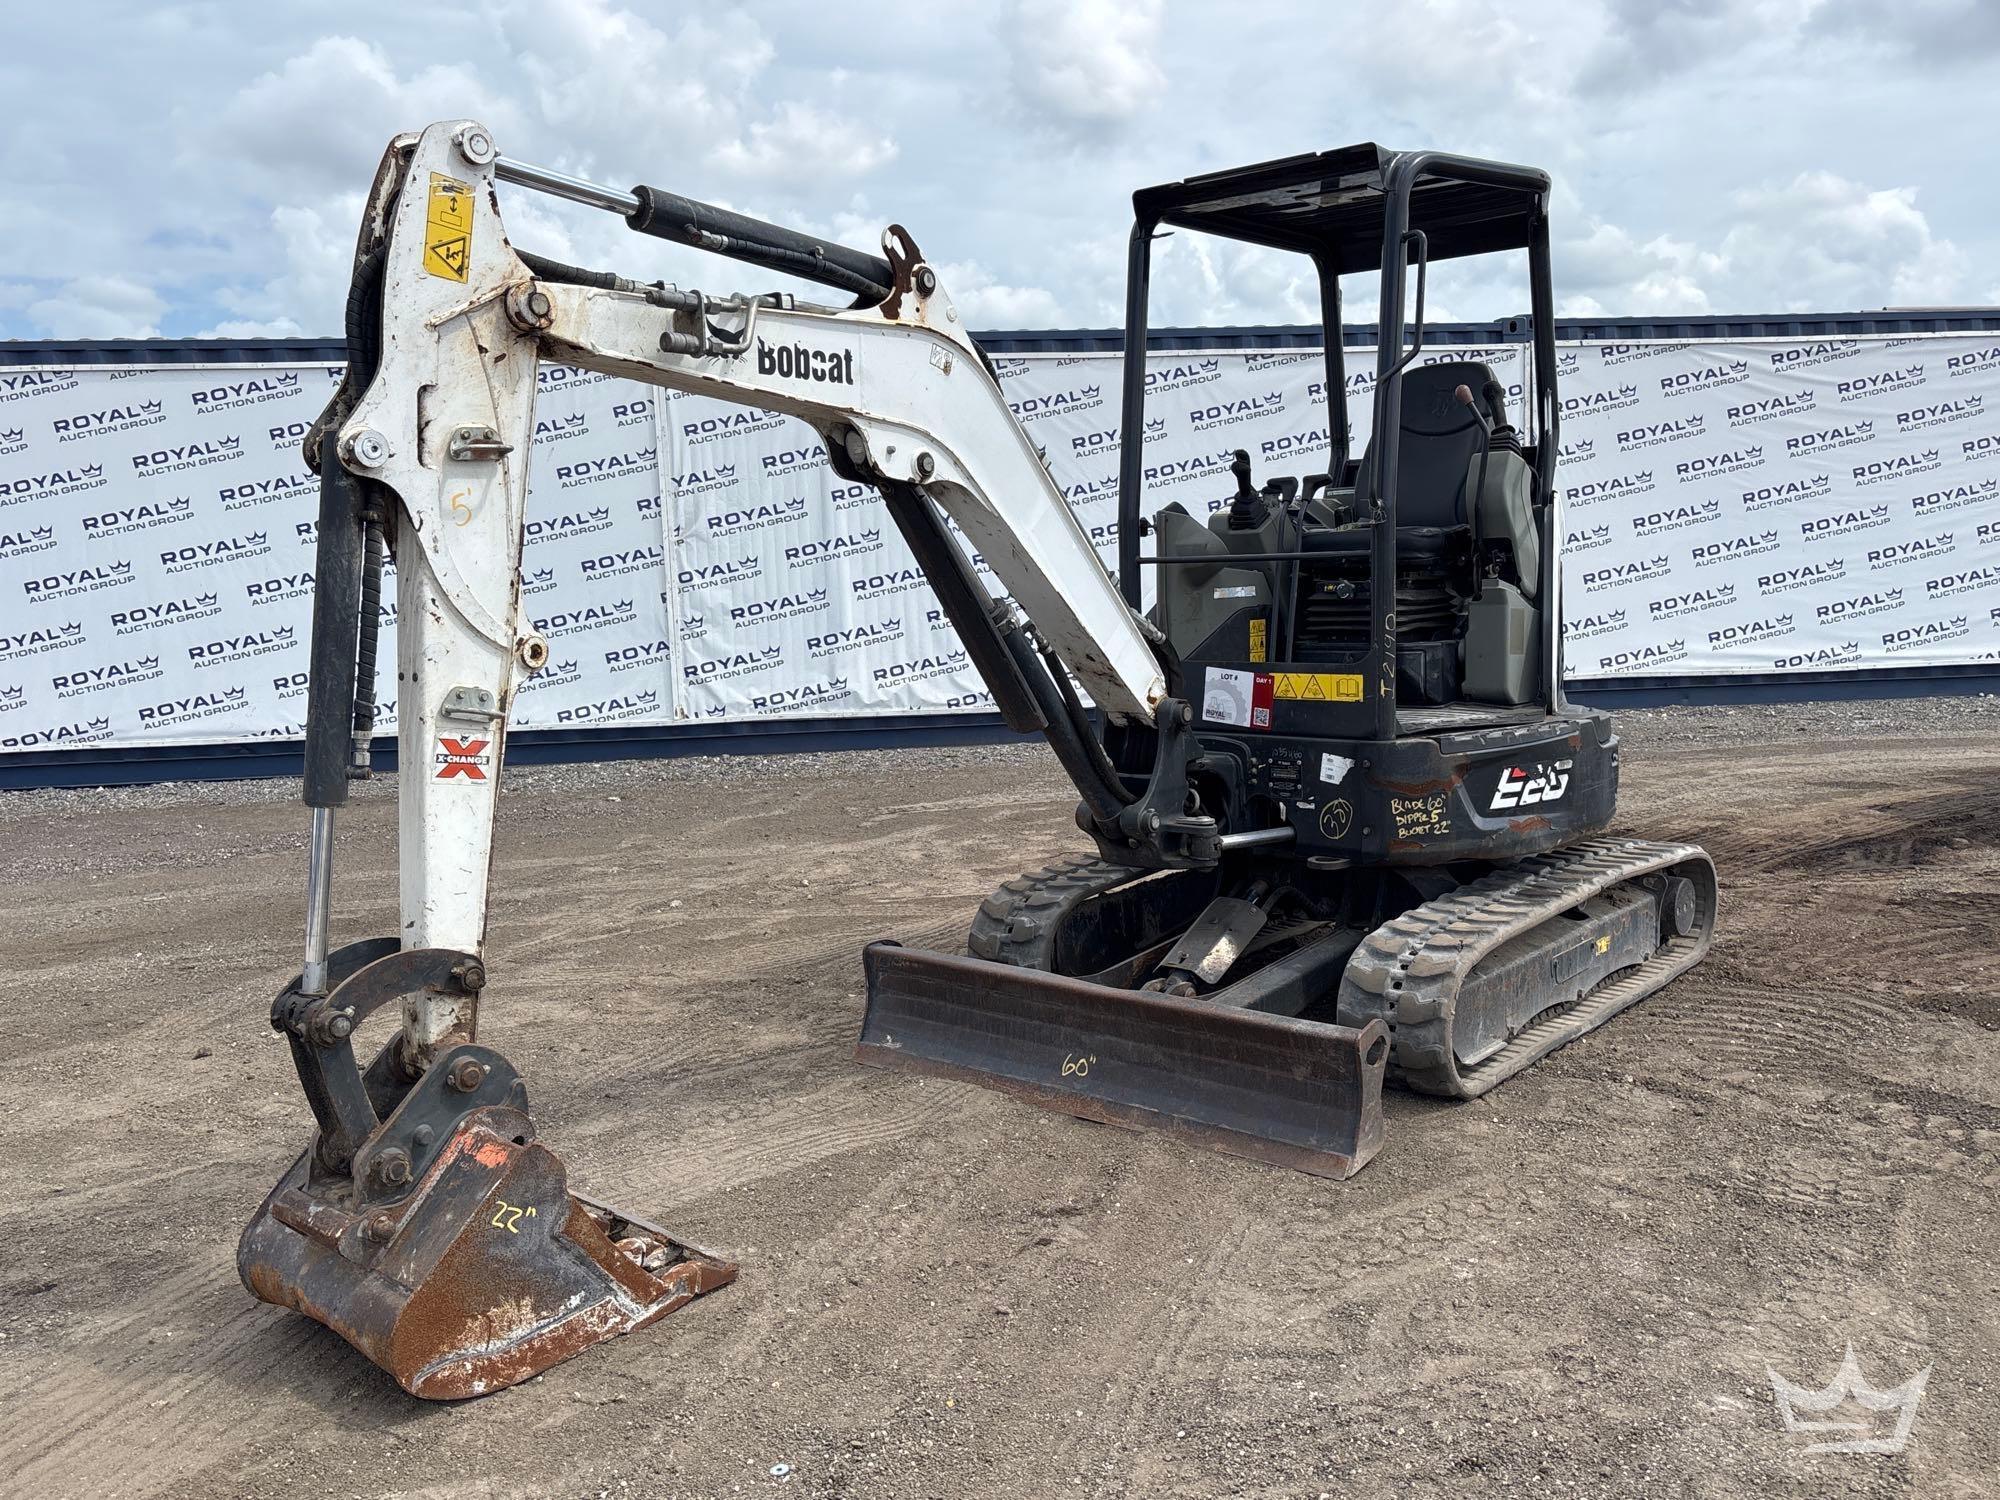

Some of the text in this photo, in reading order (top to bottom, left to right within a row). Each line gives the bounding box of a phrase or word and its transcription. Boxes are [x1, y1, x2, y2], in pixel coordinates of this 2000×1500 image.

[757, 336, 854, 385] Bobcat
[1660, 366, 1730, 390] ROYAL
[1663, 374, 1750, 398] AUCTION GROUP
[1837, 370, 1907, 395] ROYAL
[1840, 378, 1926, 403] AUCTION GROUP
[191, 379, 278, 406] ROYAL
[196, 388, 302, 415] AUCTION GROUP
[1602, 398, 1639, 412] GROUP
[1062, 399, 1103, 414] GROUP
[1190, 398, 1264, 423] ROYAL
[1193, 406, 1285, 432] AUCTION GROUP
[1726, 396, 1797, 420] ROYAL
[1729, 403, 1816, 428] AUCTION GROUP
[1897, 401, 1965, 425] ROYAL
[52, 406, 141, 434] ROYAL
[58, 415, 166, 443] AUCTION GROUP
[682, 411, 763, 437] ROYAL
[688, 419, 786, 446] AUCTION GROUP
[1616, 420, 1686, 444] ROYAL
[1899, 408, 1984, 433] AUCTION GROUP
[1620, 428, 1706, 453] AUCTION GROUP
[1786, 426, 1856, 450] ROYAL
[1789, 434, 1876, 459] AUCTION GROUP
[132, 442, 219, 469] ROYAL
[137, 451, 244, 479] AUCTION GROUP
[556, 454, 637, 480] ROYAL
[1676, 451, 1745, 475] ROYAL
[1852, 455, 1922, 479] ROYAL
[561, 462, 659, 489] AUCTION GROUP
[1144, 456, 1218, 481] ROYAL
[1147, 473, 1197, 489] AUCTION
[1679, 459, 1765, 484] AUCTION GROUP
[1855, 462, 1941, 487] AUCTION GROUP
[60, 479, 107, 494] GROUP
[1566, 476, 1635, 500] ROYAL
[1569, 484, 1655, 509] AUCTION GROUP
[1742, 480, 1812, 504] ROYAL
[1911, 485, 1980, 509] ROYAL
[1745, 488, 1831, 513] AUCTION GROUP
[1914, 492, 1999, 517] AUCTION GROUP
[81, 504, 169, 531] ROYAL
[87, 512, 194, 540] AUCTION GROUP
[708, 503, 786, 530] ROYAL
[711, 512, 808, 539] AUCTION GROUP
[1632, 505, 1702, 529] ROYAL
[1635, 513, 1721, 538] AUCTION GROUP
[1801, 510, 1871, 535] ROYAL
[1804, 517, 1891, 543] AUCTION GROUP
[159, 538, 246, 565] ROYAL
[165, 546, 271, 575] AUCTION GROUP
[580, 547, 661, 573] ROYAL
[786, 535, 861, 561] ROYAL
[789, 543, 883, 570] AUCTION GROUP
[1691, 536, 1761, 560] ROYAL
[1695, 543, 1780, 568] AUCTION GROUP
[1868, 538, 1936, 563] ROYAL
[1870, 546, 1956, 571] AUCTION GROUP
[23, 567, 110, 595] ROYAL
[585, 564, 640, 582] AUCTION
[719, 570, 762, 585] GROUP
[1582, 561, 1652, 585] ROYAL
[1586, 568, 1671, 593] AUCTION GROUP
[1757, 564, 1827, 588] ROYAL
[1760, 571, 1846, 596] AUCTION GROUP
[29, 575, 136, 604] AUCTION GROUP
[1649, 589, 1717, 614] ROYAL
[110, 599, 197, 627] ROYAL
[732, 594, 808, 621] ROYAL
[734, 602, 830, 629] AUCTION GROUP
[1652, 597, 1737, 622] AUCTION GROUP
[1817, 594, 1885, 618] ROYAL
[1819, 601, 1905, 626] AUCTION GROUP
[116, 607, 222, 636] AUCTION GROUP
[594, 613, 637, 629] GROUP
[1708, 619, 1776, 644] ROYAL
[1882, 621, 1950, 646] ROYAL
[188, 632, 273, 660] ROYAL
[807, 624, 882, 650] ROYAL
[810, 632, 904, 659] AUCTION GROUP
[1711, 626, 1796, 652] AUCTION GROUP
[1885, 628, 1969, 653] AUCTION GROUP
[193, 640, 298, 669] AUCTION GROUP
[684, 652, 762, 679] ROYAL
[52, 662, 138, 690] ROYAL
[687, 660, 784, 688] AUCTION GROUP
[874, 656, 948, 681] ROYAL
[877, 663, 969, 690] AUCTION GROUP
[57, 670, 164, 699] AUCTION GROUP
[751, 684, 829, 710] ROYAL
[138, 693, 224, 721] ROYAL
[810, 691, 851, 705] GROUP
[144, 701, 249, 730] AUCTION GROUP
[1206, 709, 1226, 717] ROYAL
[1062, 1053, 1097, 1077] 60"
[491, 1200, 537, 1234] 22"
